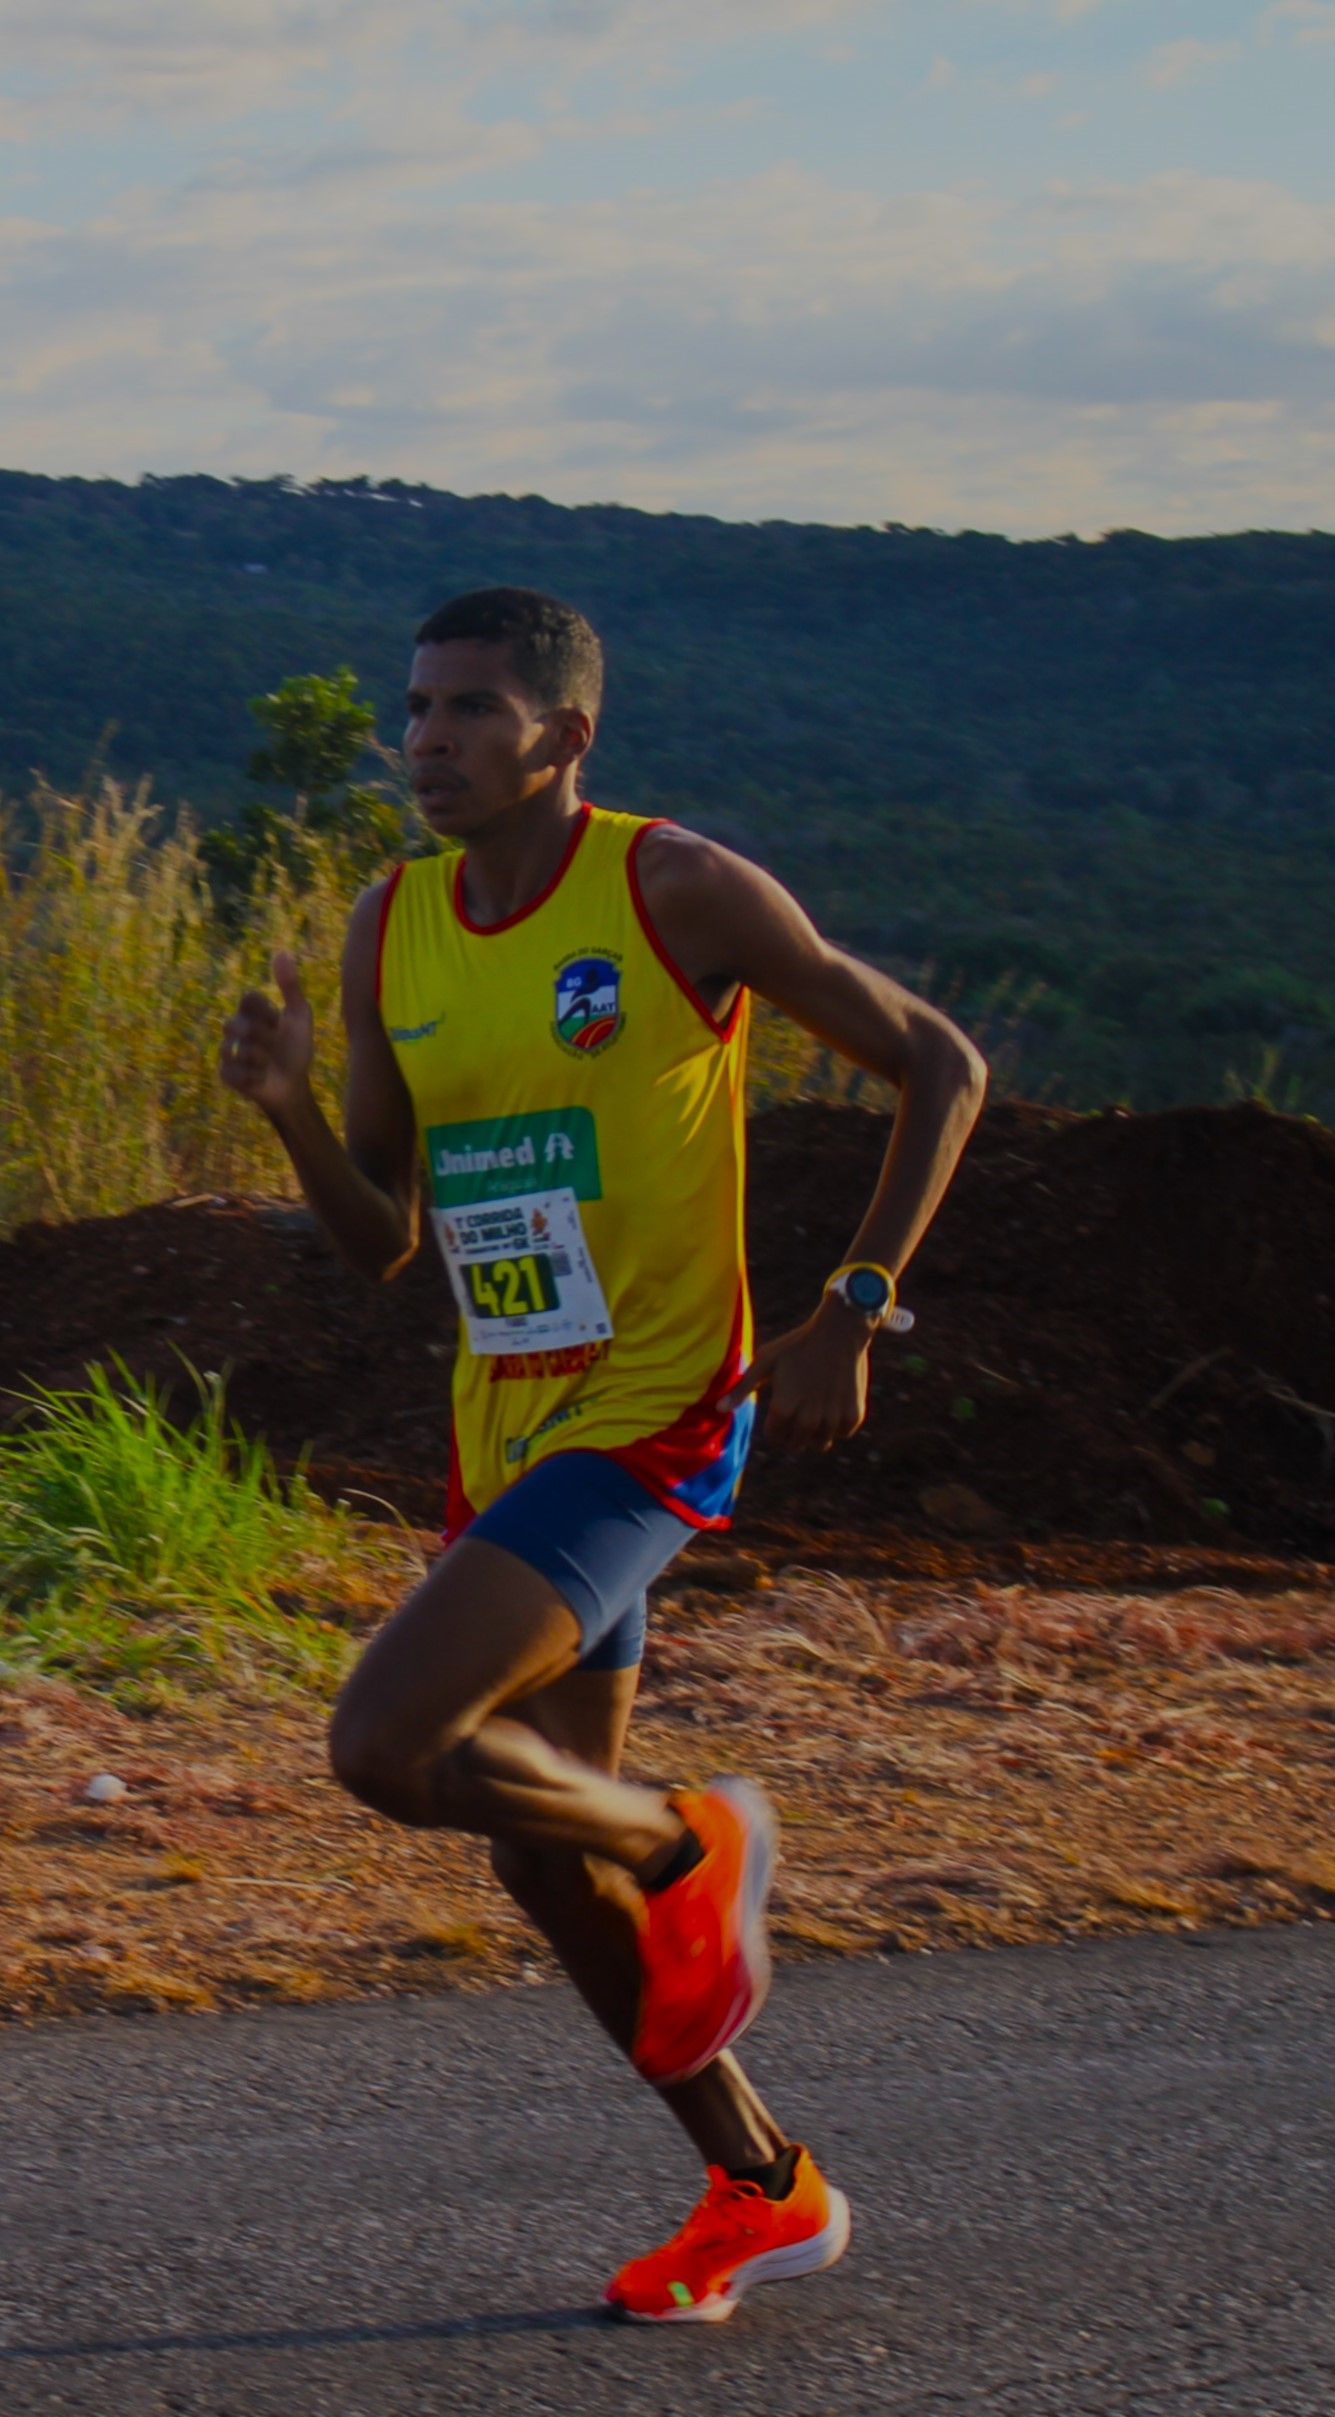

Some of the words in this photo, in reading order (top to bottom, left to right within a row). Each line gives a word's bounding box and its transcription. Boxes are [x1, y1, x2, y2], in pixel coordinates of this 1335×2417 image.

[466, 1206, 524, 1228] CORRIDA
[460, 1230, 479, 1245] DO
[481, 1221, 527, 1241] MILHO
[471, 1255, 545, 1317] 421
